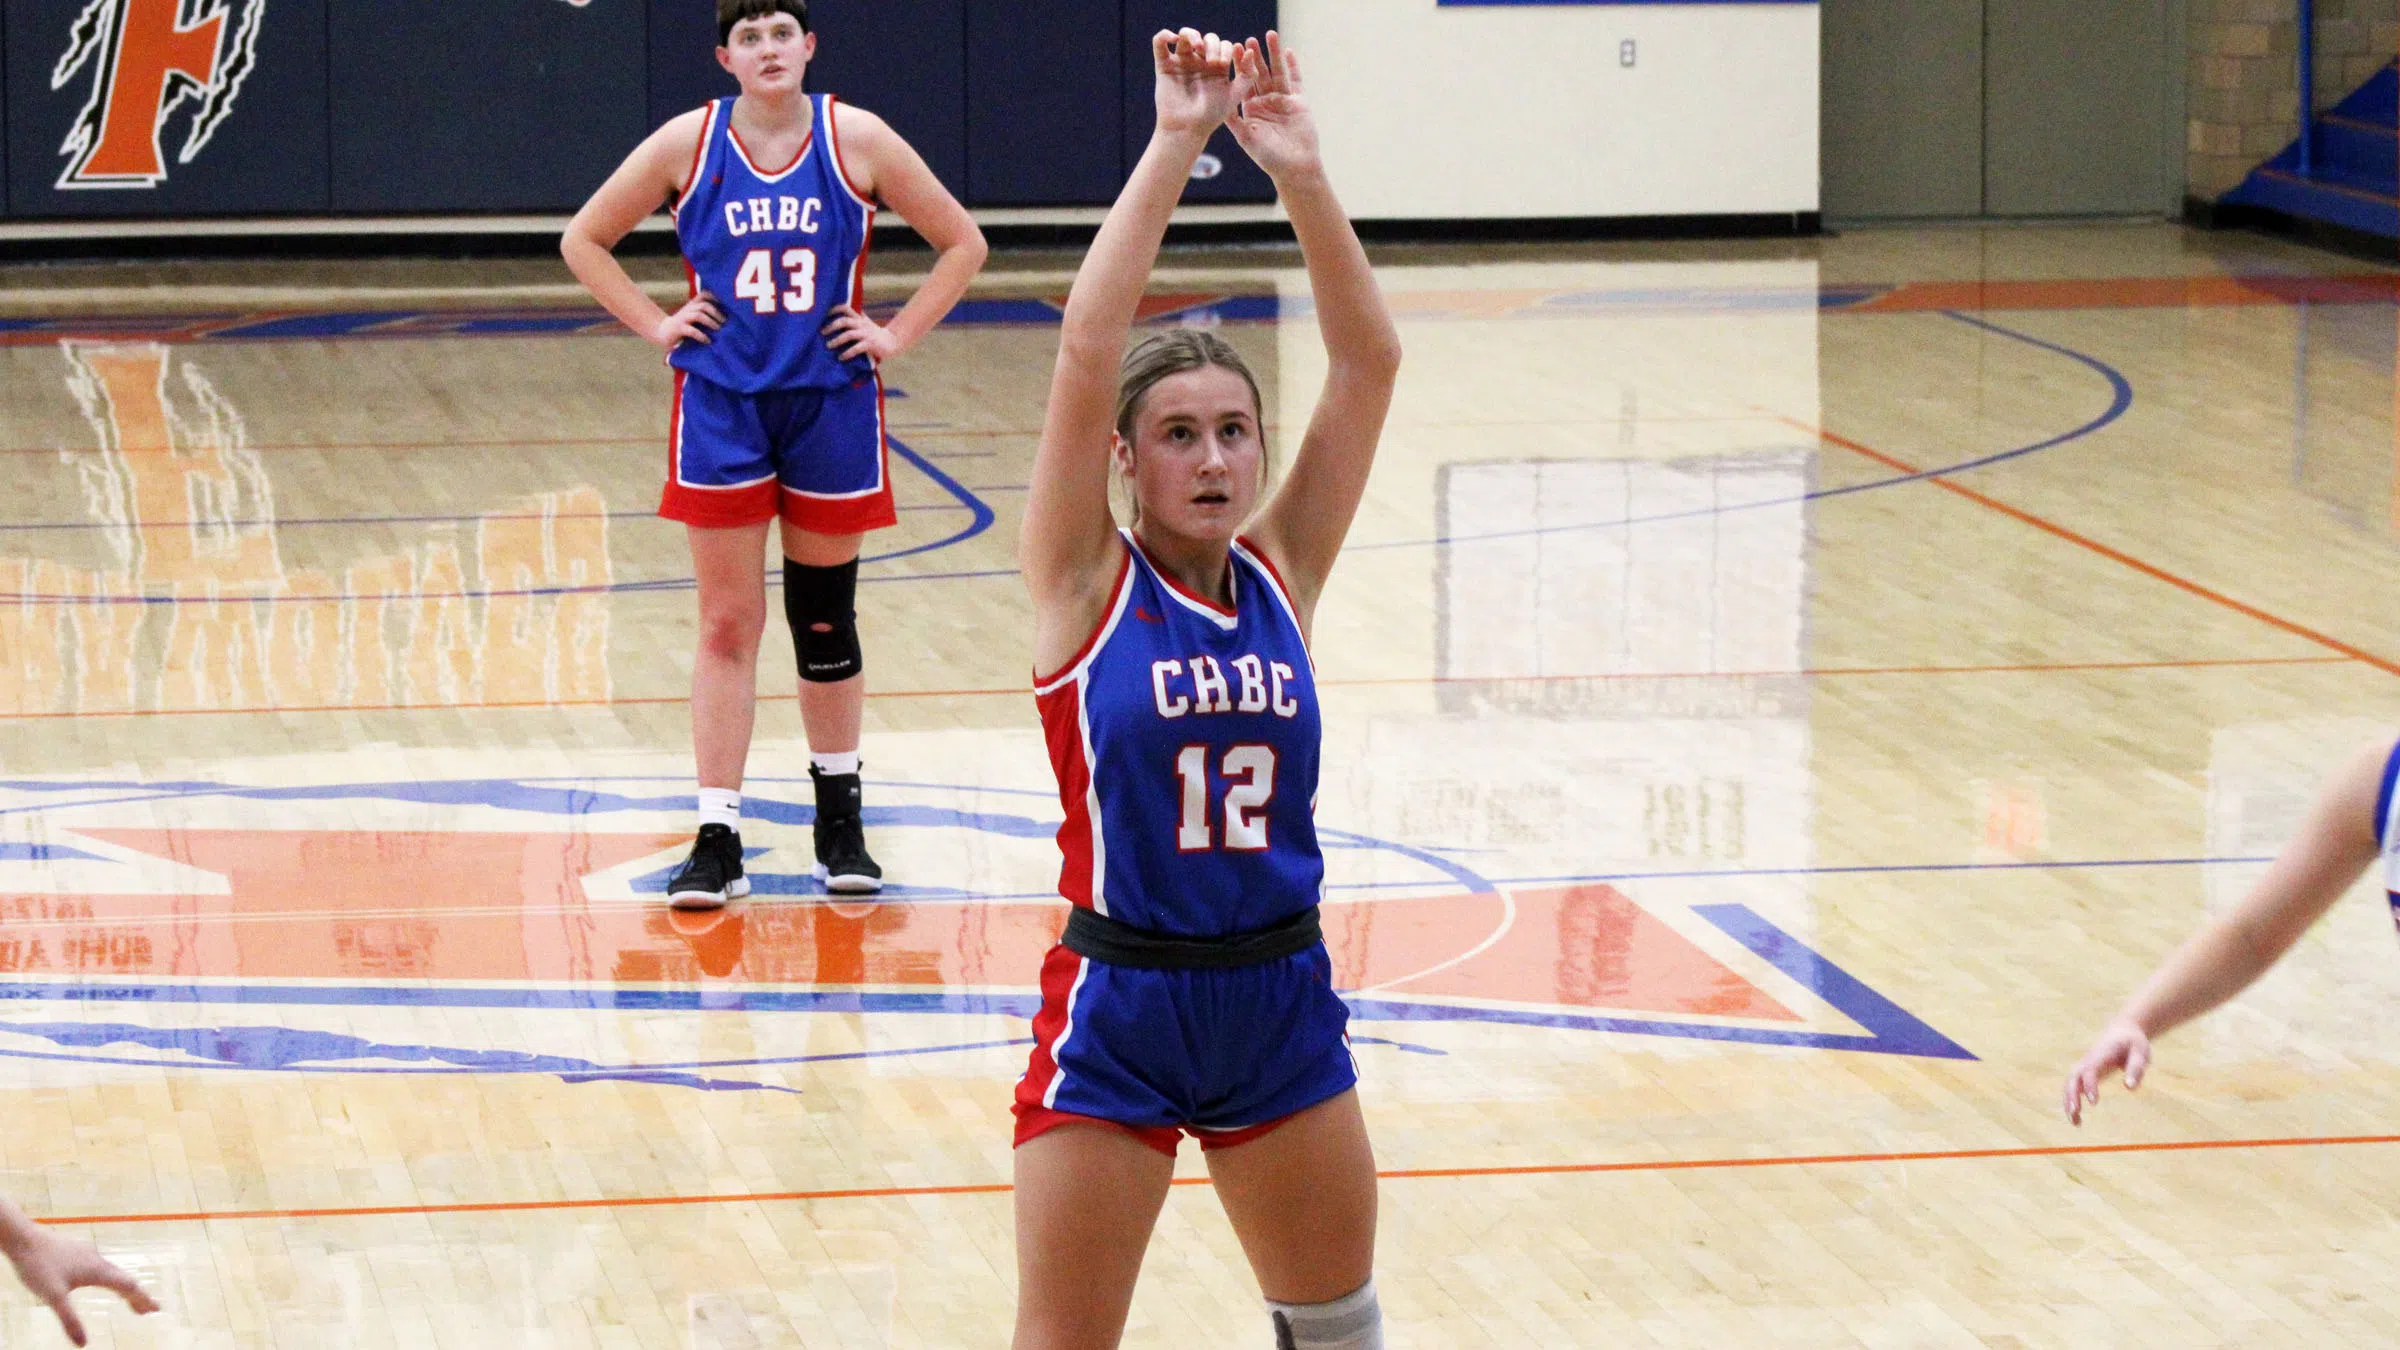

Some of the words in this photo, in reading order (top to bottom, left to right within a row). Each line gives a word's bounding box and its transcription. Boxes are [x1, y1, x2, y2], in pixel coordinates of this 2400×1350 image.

[724, 195, 822, 237] CHBC
[734, 247, 818, 314] 43
[1151, 654, 1298, 719] CHBC
[1174, 743, 1278, 853] 12
